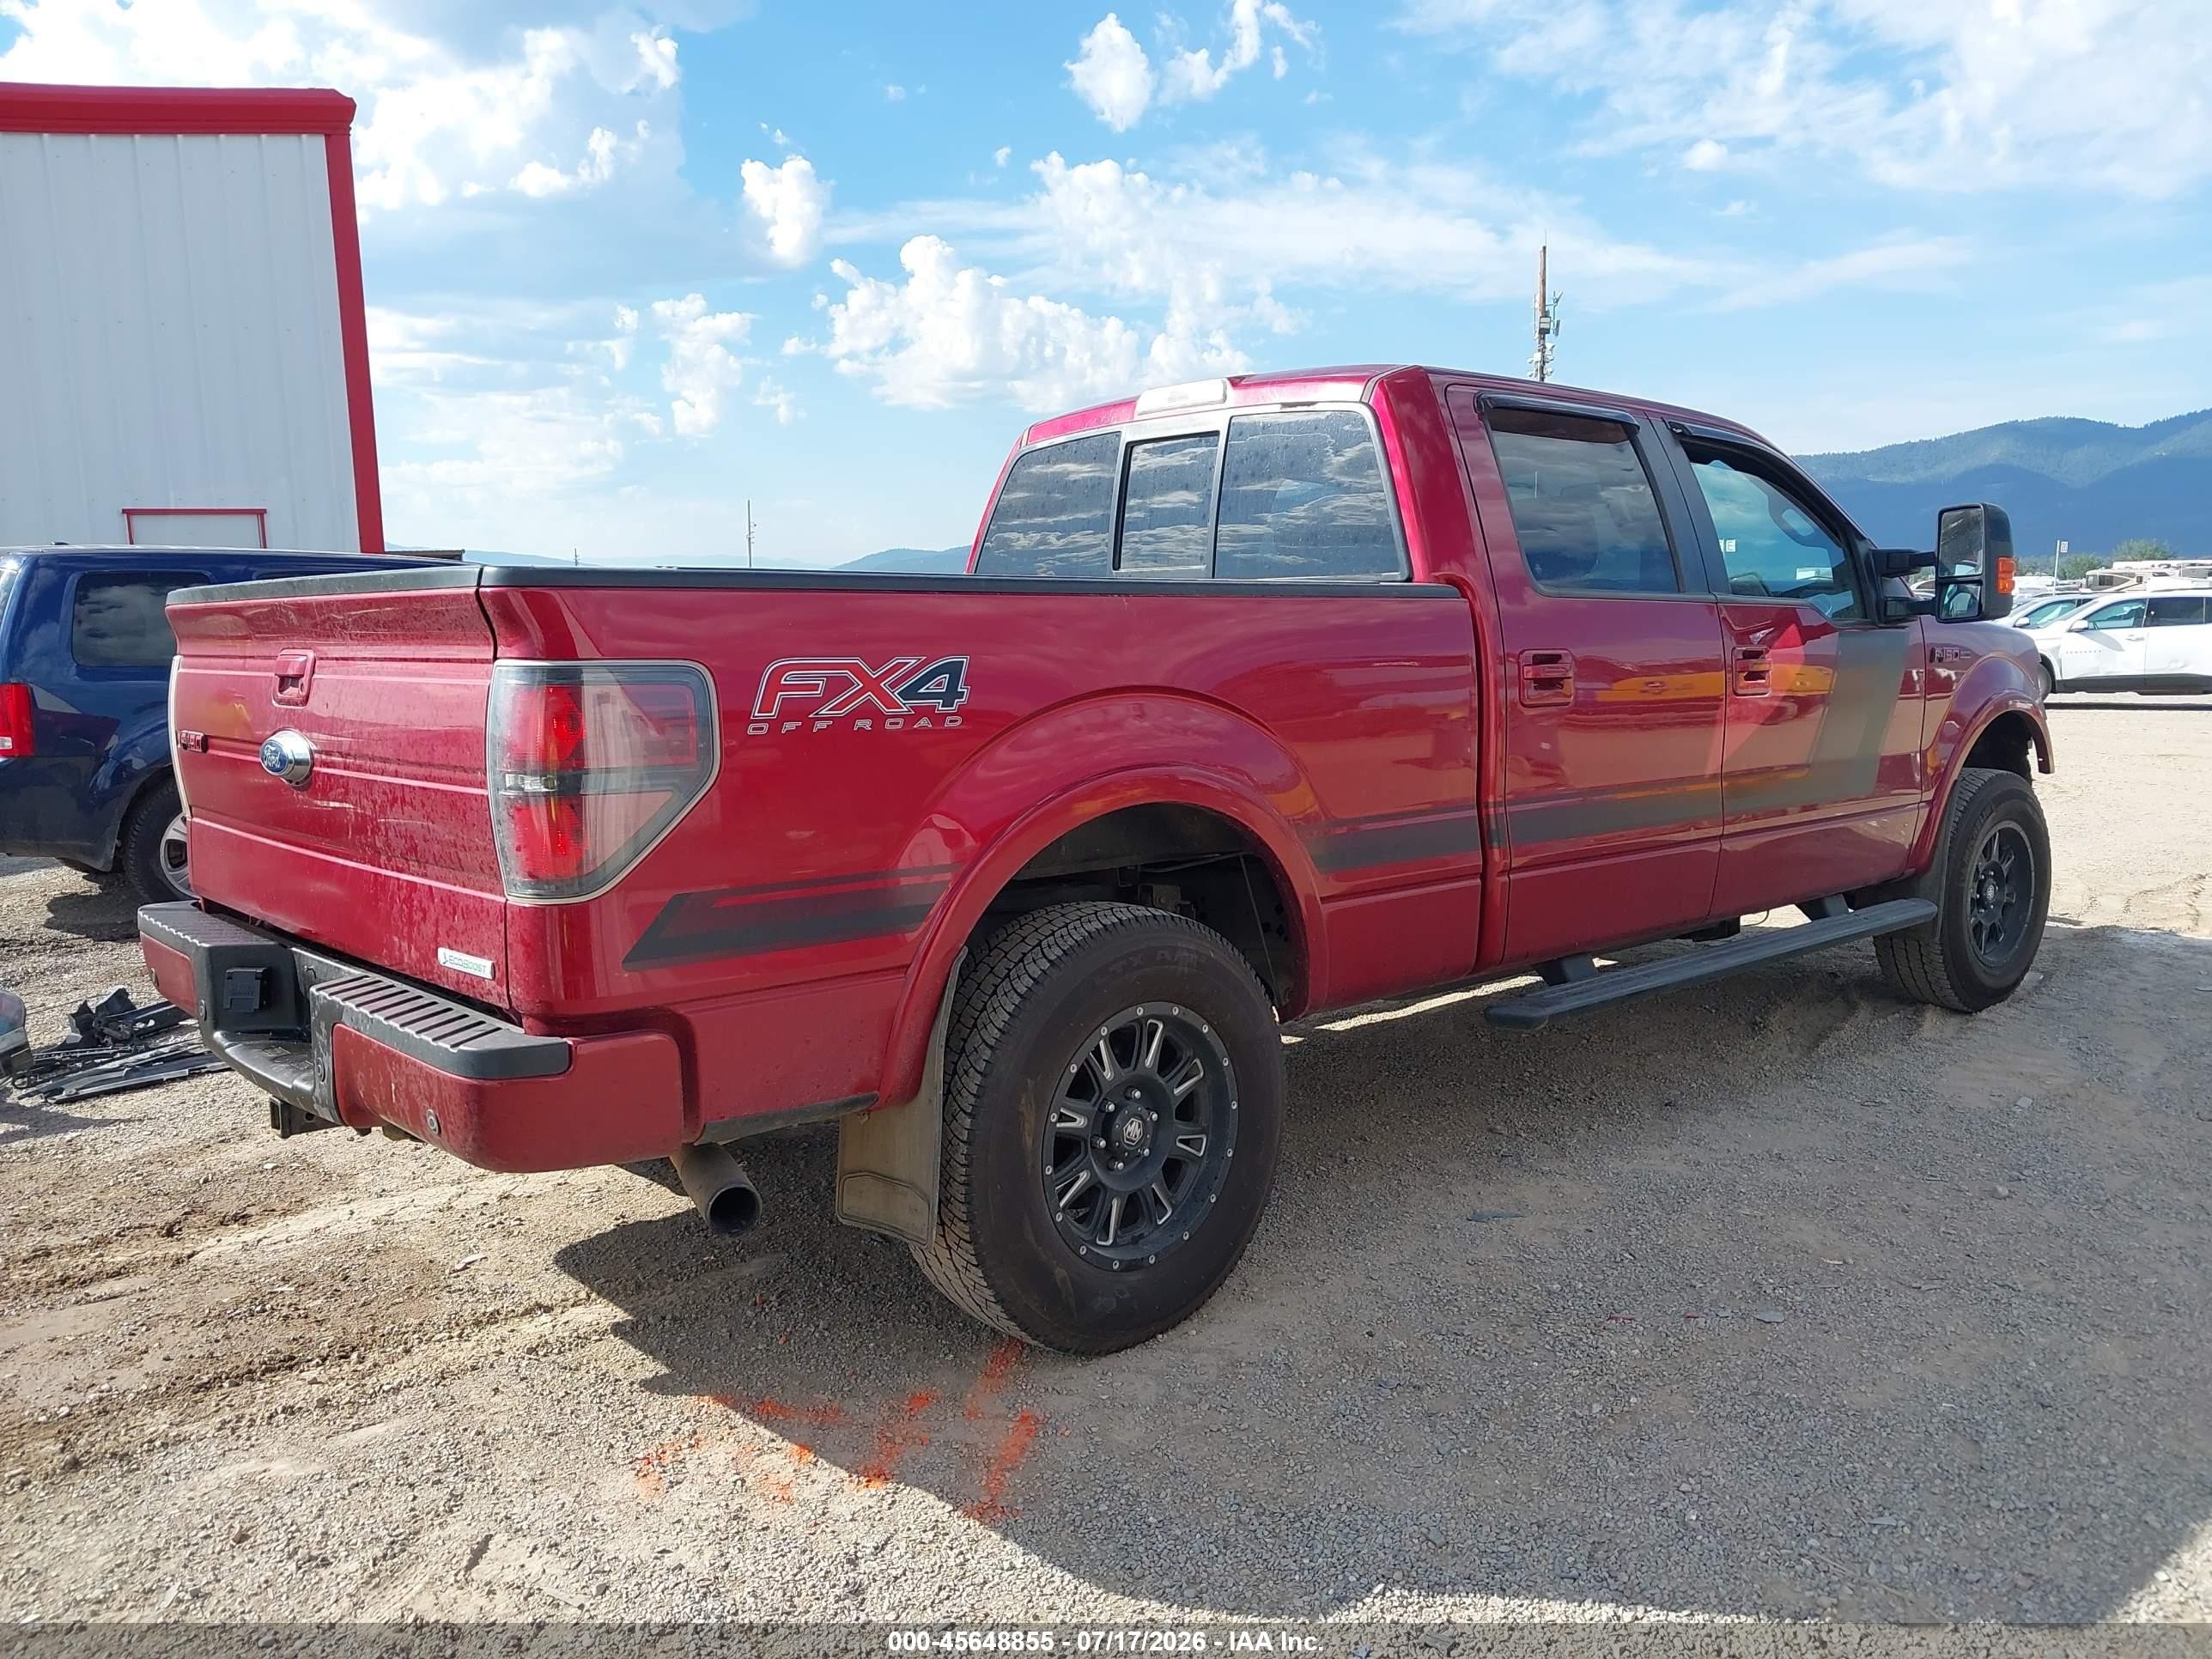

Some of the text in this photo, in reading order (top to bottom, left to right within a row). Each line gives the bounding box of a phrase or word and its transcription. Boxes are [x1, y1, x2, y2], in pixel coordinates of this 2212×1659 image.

[750, 655, 970, 719] FX4
[747, 716, 963, 735] OFF ROAD
[263, 744, 281, 769] Ford
